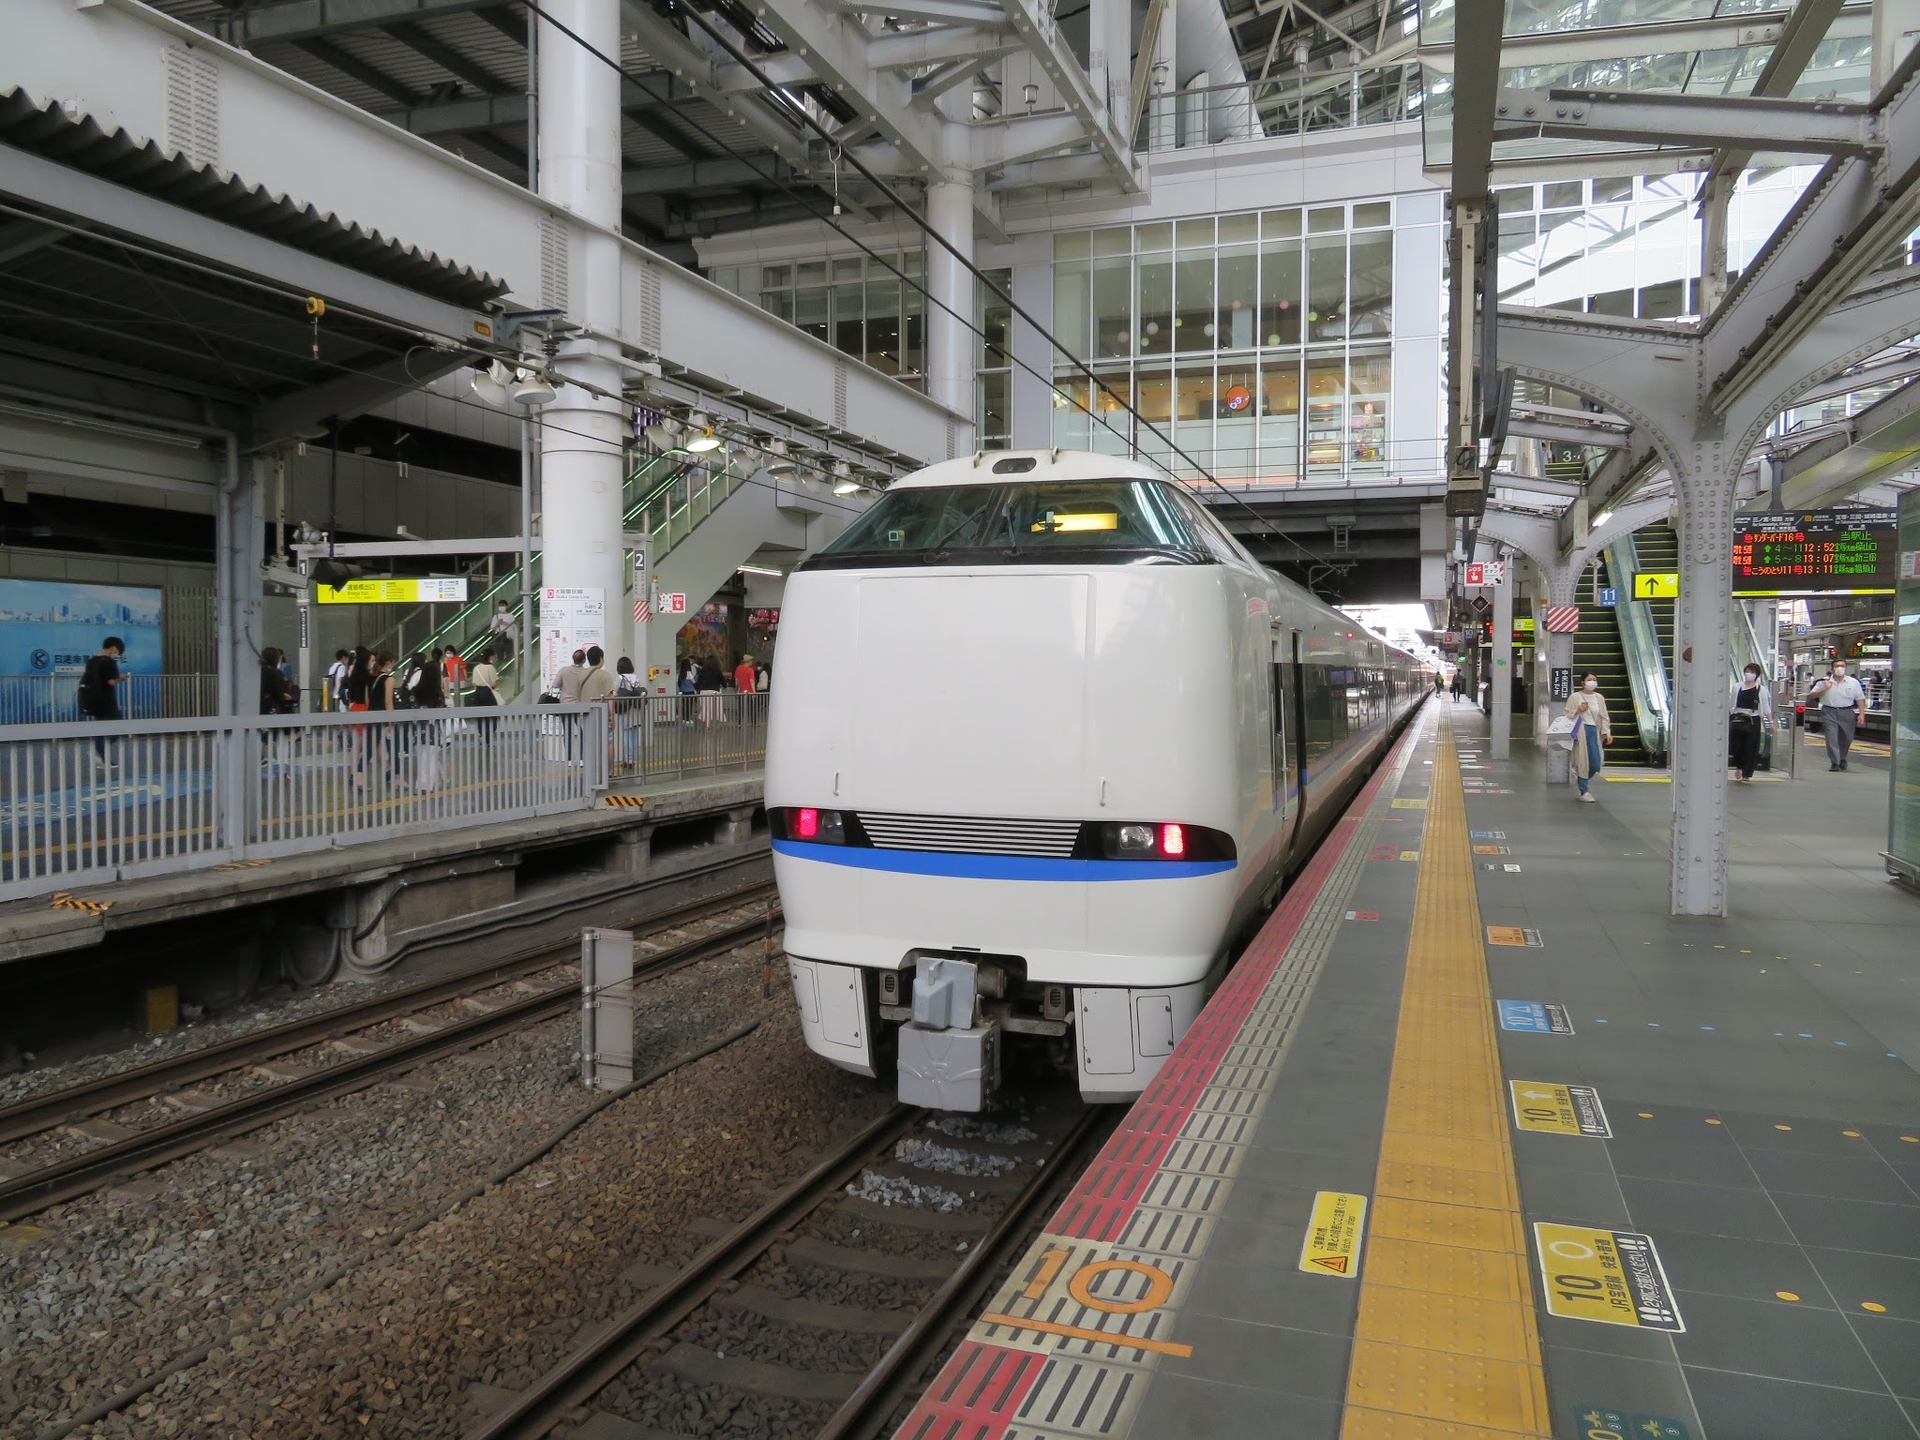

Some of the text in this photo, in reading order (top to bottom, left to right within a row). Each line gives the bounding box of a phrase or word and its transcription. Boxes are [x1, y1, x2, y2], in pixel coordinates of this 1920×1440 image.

[1840, 531, 1872, 541] 当駅止
[635, 553, 644, 567] 2
[299, 562, 306, 575] 1
[1602, 590, 1616, 601] 11
[597, 602, 603, 610] 2
[1507, 1015, 1533, 1026] 10
[1523, 1108, 1557, 1123] 10
[1022, 1250, 1174, 1314] 10
[1627, 1251, 1661, 1309] 2列にお並びください
[1554, 1274, 1605, 1303] 10
[1605, 1275, 1631, 1313] JR宝塚線
